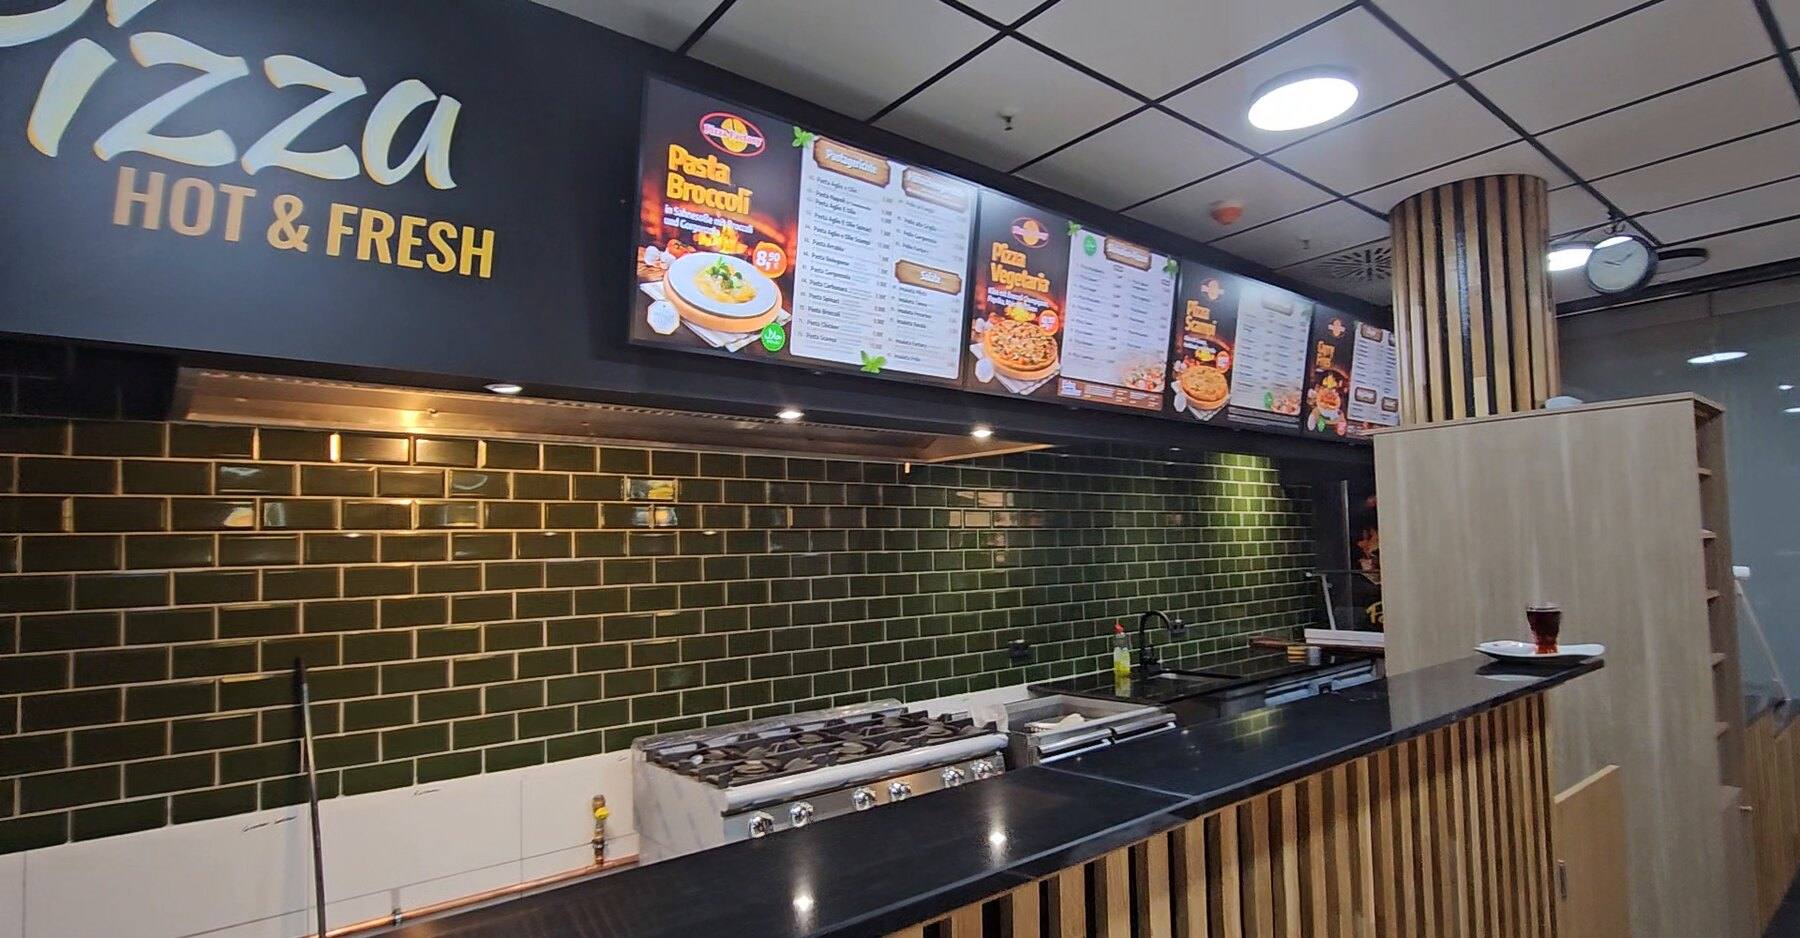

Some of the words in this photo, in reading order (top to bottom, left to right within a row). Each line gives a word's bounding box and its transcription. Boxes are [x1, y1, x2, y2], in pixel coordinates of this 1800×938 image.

[0, 0, 461, 190] izza
[666, 171, 753, 214] Broccoli
[668, 143, 731, 185] Pasta
[113, 166, 257, 242] HOT
[266, 194, 308, 252] &
[325, 203, 495, 278] FRESH
